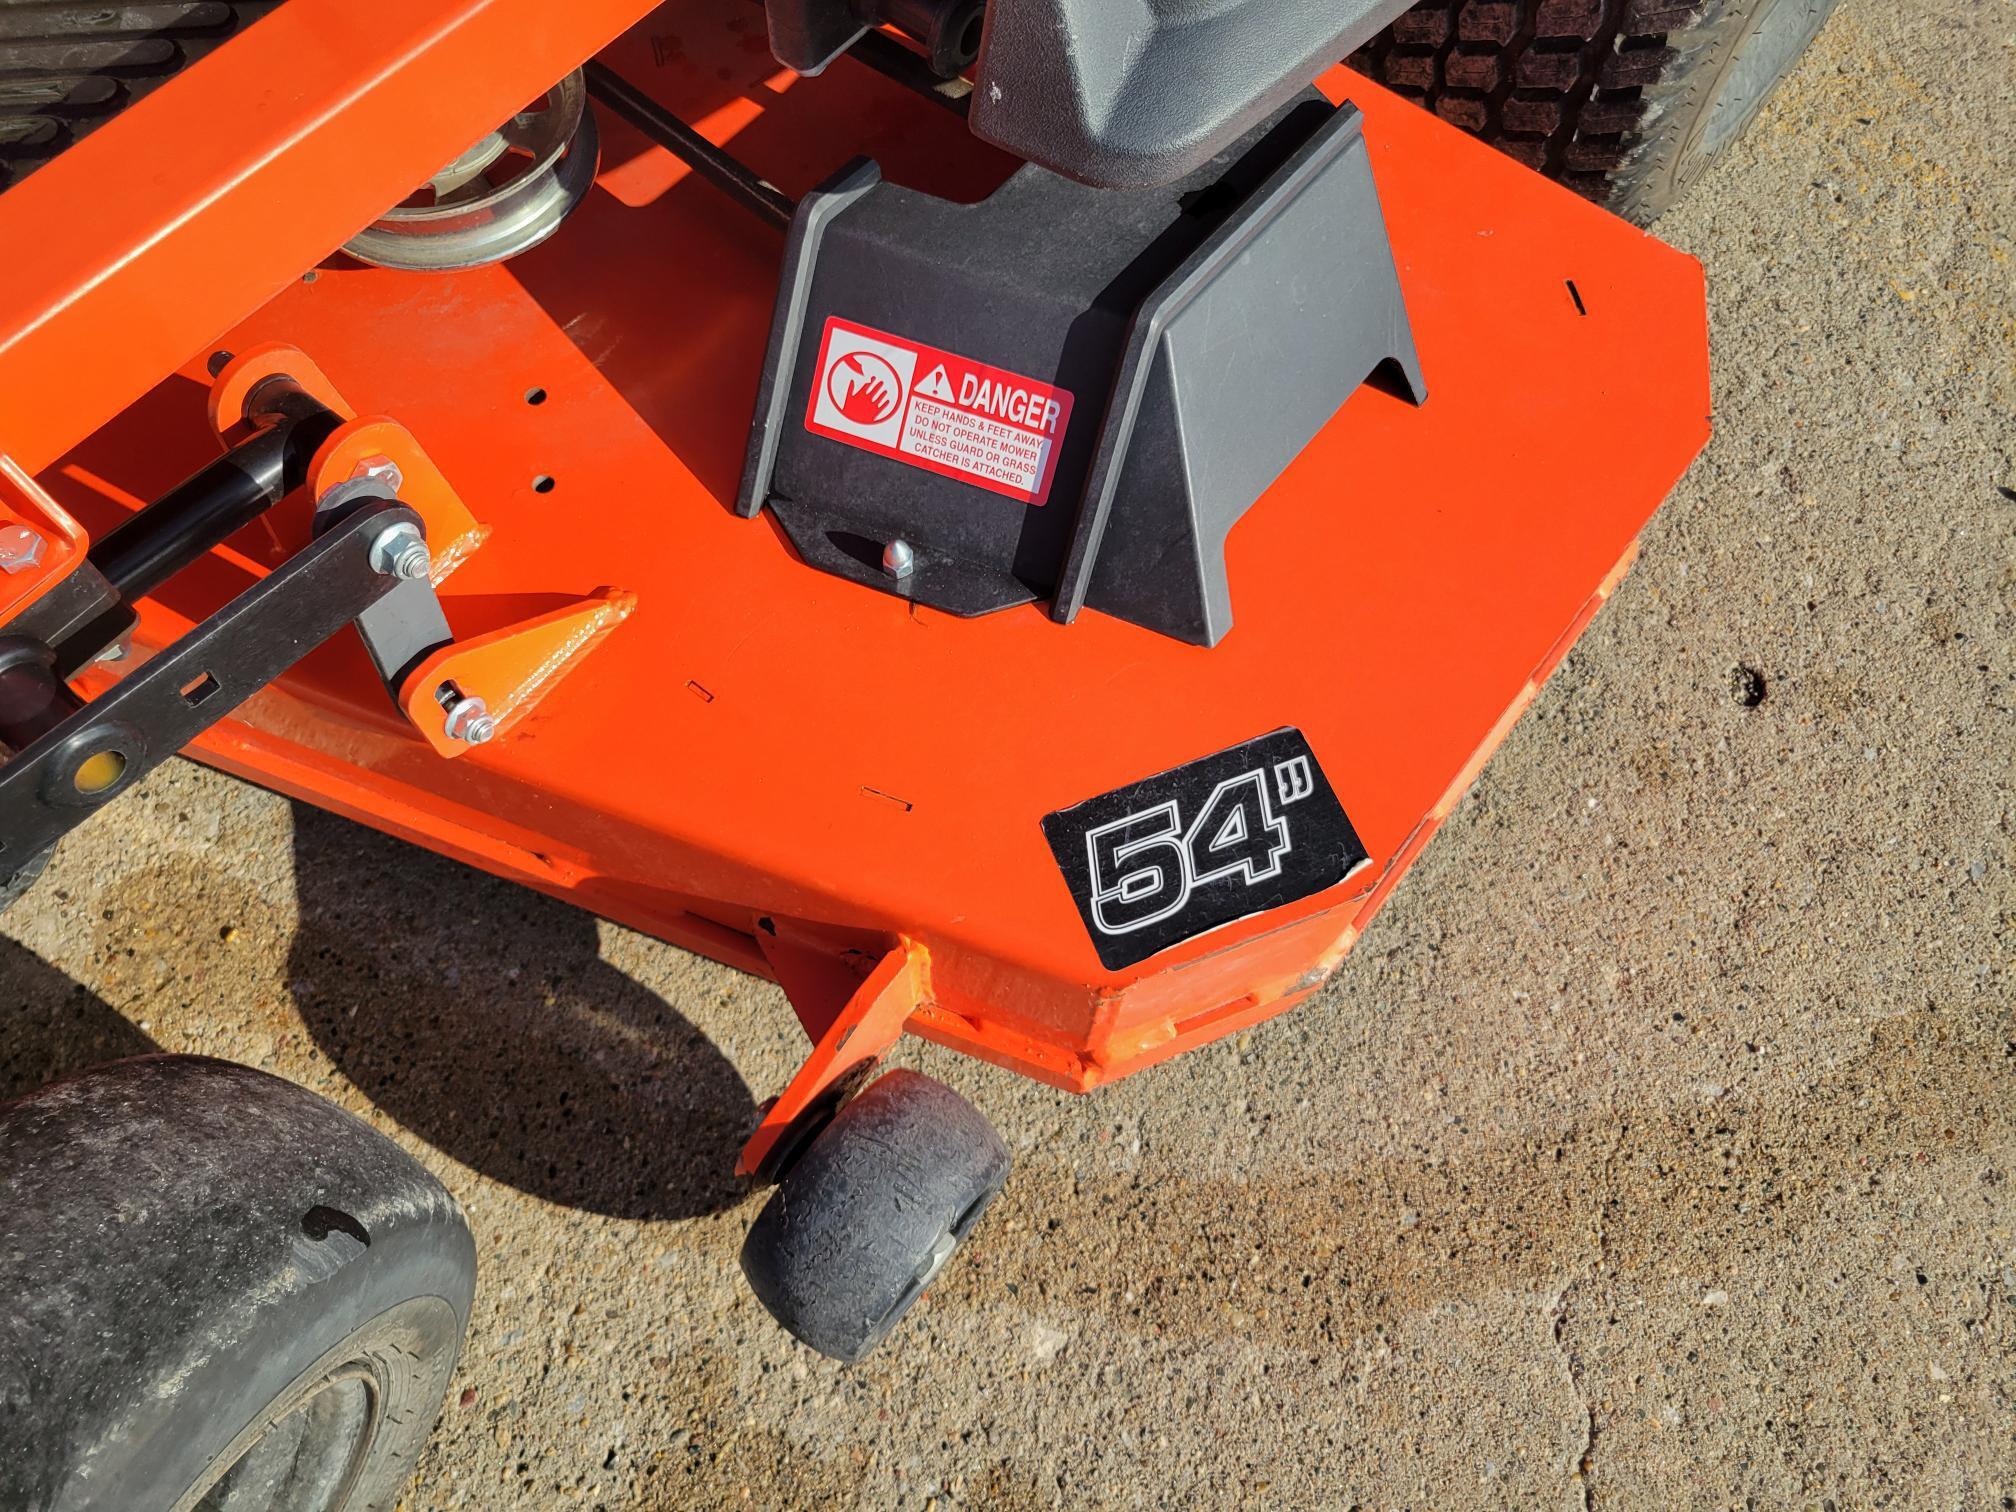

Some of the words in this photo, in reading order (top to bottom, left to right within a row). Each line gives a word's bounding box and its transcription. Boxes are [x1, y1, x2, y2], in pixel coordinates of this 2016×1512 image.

[914, 401, 941, 416] KEEP
[942, 410, 976, 428] HANDS
[978, 421, 985, 431] &
[987, 424, 1013, 439] FEET
[958, 372, 1060, 434] DANGER
[909, 427, 947, 446] UNLESS
[950, 440, 984, 458] GUARD
[985, 451, 1000, 463] OR
[1002, 457, 1036, 475] GRASS
[915, 415, 929, 427] DO
[931, 420, 951, 433] NOT
[953, 427, 998, 449] OPERATE
[999, 442, 1037, 462] MOWER
[914, 442, 959, 464] CATCHER
[961, 457, 970, 467] IS
[972, 461, 1024, 485] ATTACHED.
